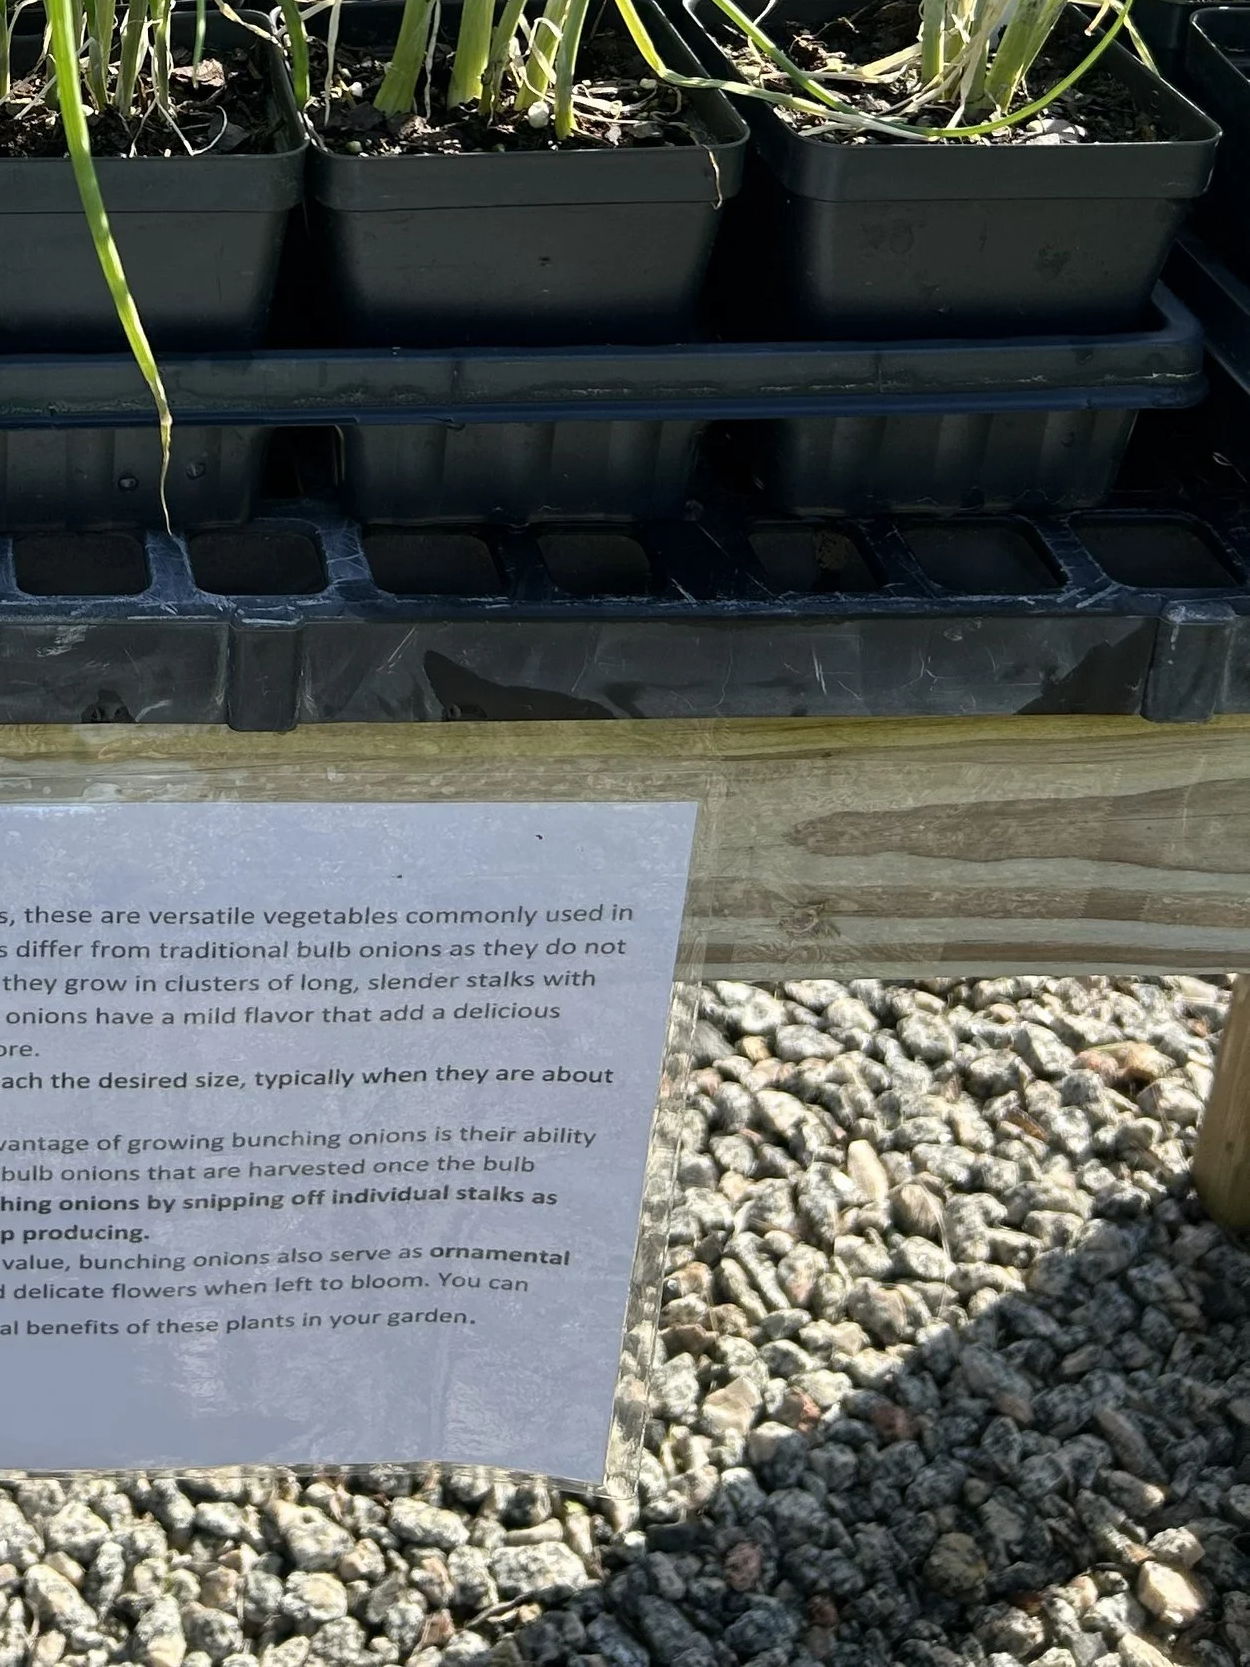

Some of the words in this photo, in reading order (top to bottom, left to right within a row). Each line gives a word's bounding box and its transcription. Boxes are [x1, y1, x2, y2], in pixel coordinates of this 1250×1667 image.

[23, 905, 93, 924] these
[100, 910, 141, 925] are
[148, 906, 255, 925] versatile
[263, 906, 398, 929] vegetables
[405, 905, 538, 927] commonly
[546, 903, 604, 923] used
[611, 903, 633, 922] in
[2, 973, 58, 996] they
[64, 978, 128, 996] grow
[135, 975, 157, 992] in
[164, 974, 260, 993] clusters
[267, 973, 295, 991] of
[300, 973, 359, 995] long,
[367, 972, 460, 991] slender
[466, 970, 535, 988] stalks
[542, 969, 596, 987] with
[5, 1007, 88, 1025] onions
[96, 1007, 154, 1025] have
[161, 1012, 175, 1025] a
[183, 1006, 236, 1025] mild
[244, 1006, 315, 1024] flavor
[321, 1005, 372, 1023] that
[379, 1003, 425, 1022] add
[432, 1007, 445, 1020] a
[453, 1002, 561, 1020] delicious
[50, 1071, 91, 1090] the
[98, 1071, 188, 1090] desired
[195, 1071, 246, 1090] size,
[254, 1068, 355, 1090] typically
[361, 1066, 427, 1085] when
[435, 1064, 490, 1085] they
[495, 1068, 535, 1082] are
[541, 1065, 615, 1084] about
[96, 1134, 122, 1151] of
[127, 1134, 225, 1155] growing
[231, 1130, 341, 1150] bunching
[348, 1128, 427, 1146] onions
[434, 1126, 452, 1142] is
[459, 1125, 517, 1142] their
[522, 1126, 597, 1149] ability
[58, 1195, 140, 1211] onions
[147, 1194, 177, 1214] by
[182, 1191, 285, 1212] snipping
[291, 1189, 326, 1206] off
[332, 1184, 450, 1205] individual
[455, 1185, 525, 1203] stalks
[531, 1192, 558, 1206] as
[1, 1254, 71, 1272] value,
[79, 1253, 186, 1272] bunching
[192, 1251, 270, 1268] onions
[277, 1247, 323, 1264] also
[329, 1248, 391, 1263] serve
[398, 1247, 423, 1259] as
[429, 1246, 571, 1266] ornamental
[13, 1283, 104, 1300] delicate
[111, 1282, 197, 1299] flowers
[204, 1279, 267, 1296] when
[275, 1276, 313, 1293] left
[319, 1277, 344, 1291] to
[350, 1273, 430, 1290] bloom.
[438, 1272, 481, 1288] You
[488, 1278, 529, 1292] can
[26, 1319, 120, 1335] benefits
[126, 1318, 151, 1335] of
[156, 1318, 219, 1335] these
[225, 1314, 295, 1335] plants
[302, 1312, 322, 1327] in
[329, 1313, 382, 1330] your
[387, 1307, 476, 1327] garden.
